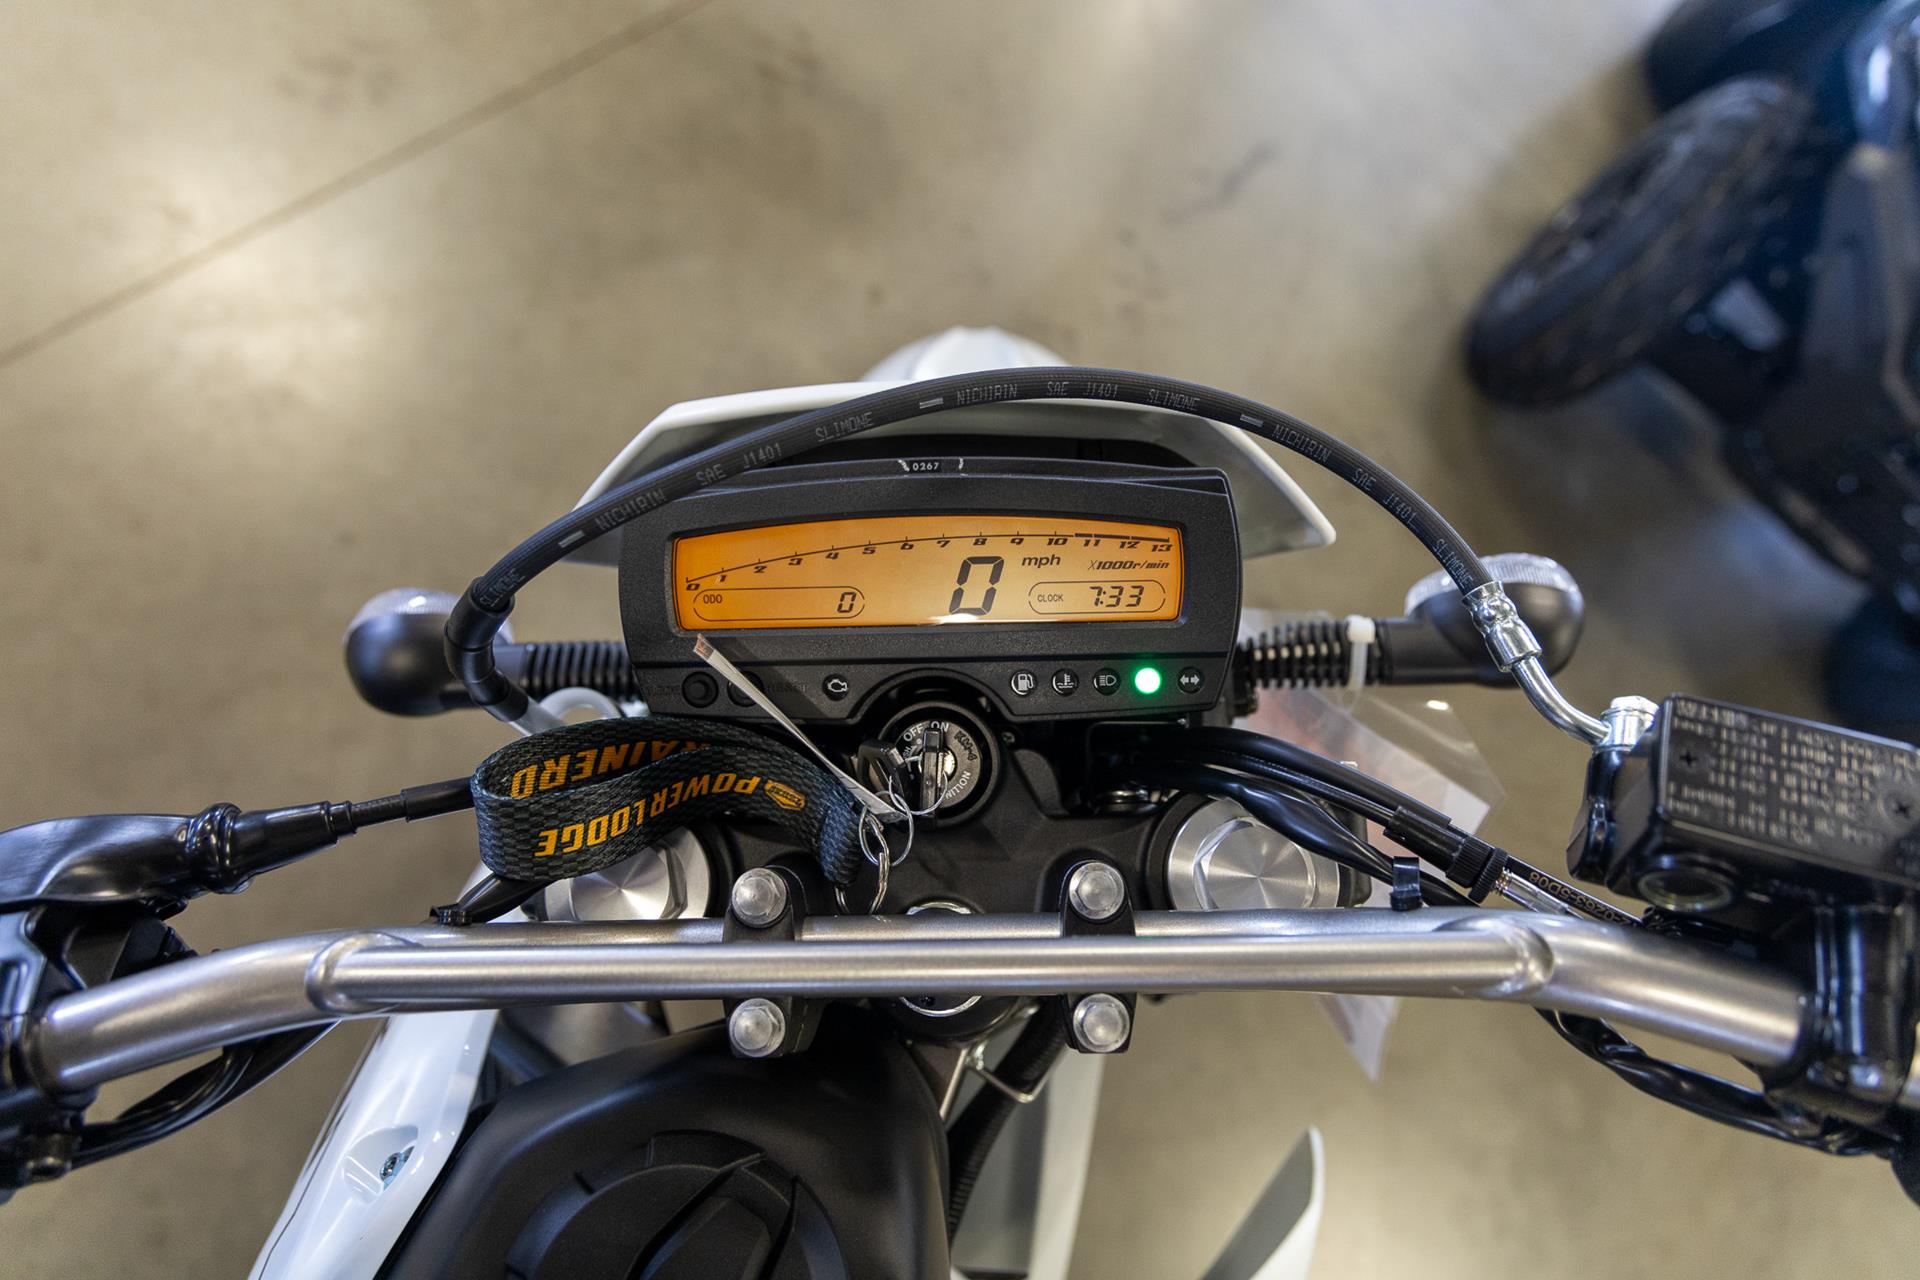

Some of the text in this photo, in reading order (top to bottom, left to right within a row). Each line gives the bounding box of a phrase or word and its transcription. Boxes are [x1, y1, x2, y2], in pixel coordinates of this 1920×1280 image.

[956, 383, 1018, 405] NICHIRIN
[1046, 381, 1069, 397] SAE
[1083, 383, 1119, 399] J1401
[695, 464, 727, 487] SAE
[742, 442, 783, 468] J1401
[814, 411, 875, 443] SLIMONE
[1271, 423, 1333, 463] NICHIRIN
[1350, 467, 1378, 492] SAE
[912, 461, 940, 472] 0267
[686, 583, 701, 592] 0
[753, 565, 768, 574] 2
[788, 557, 804, 566] 3
[825, 551, 840, 560] 4
[862, 546, 877, 555] 5
[900, 542, 915, 551] 6
[936, 540, 952, 548] 7
[972, 538, 988, 547] 8
[1010, 537, 1025, 546] 9
[1046, 538, 1069, 547] 10
[1083, 539, 1102, 548] 11
[1119, 540, 1142, 549] 12
[1151, 544, 1174, 553] 13
[1021, 554, 1062, 570] mph
[949, 555, 1005, 616] 0
[1037, 585, 1145, 608] CLOCK 7:33
[702, 591, 857, 614] ODO 0
[903, 723, 924, 742] OFF
[930, 720, 949, 733] ON
[650, 773, 761, 818] POWER
[945, 771, 972, 800] NITION
[534, 799, 648, 858] LODGE
